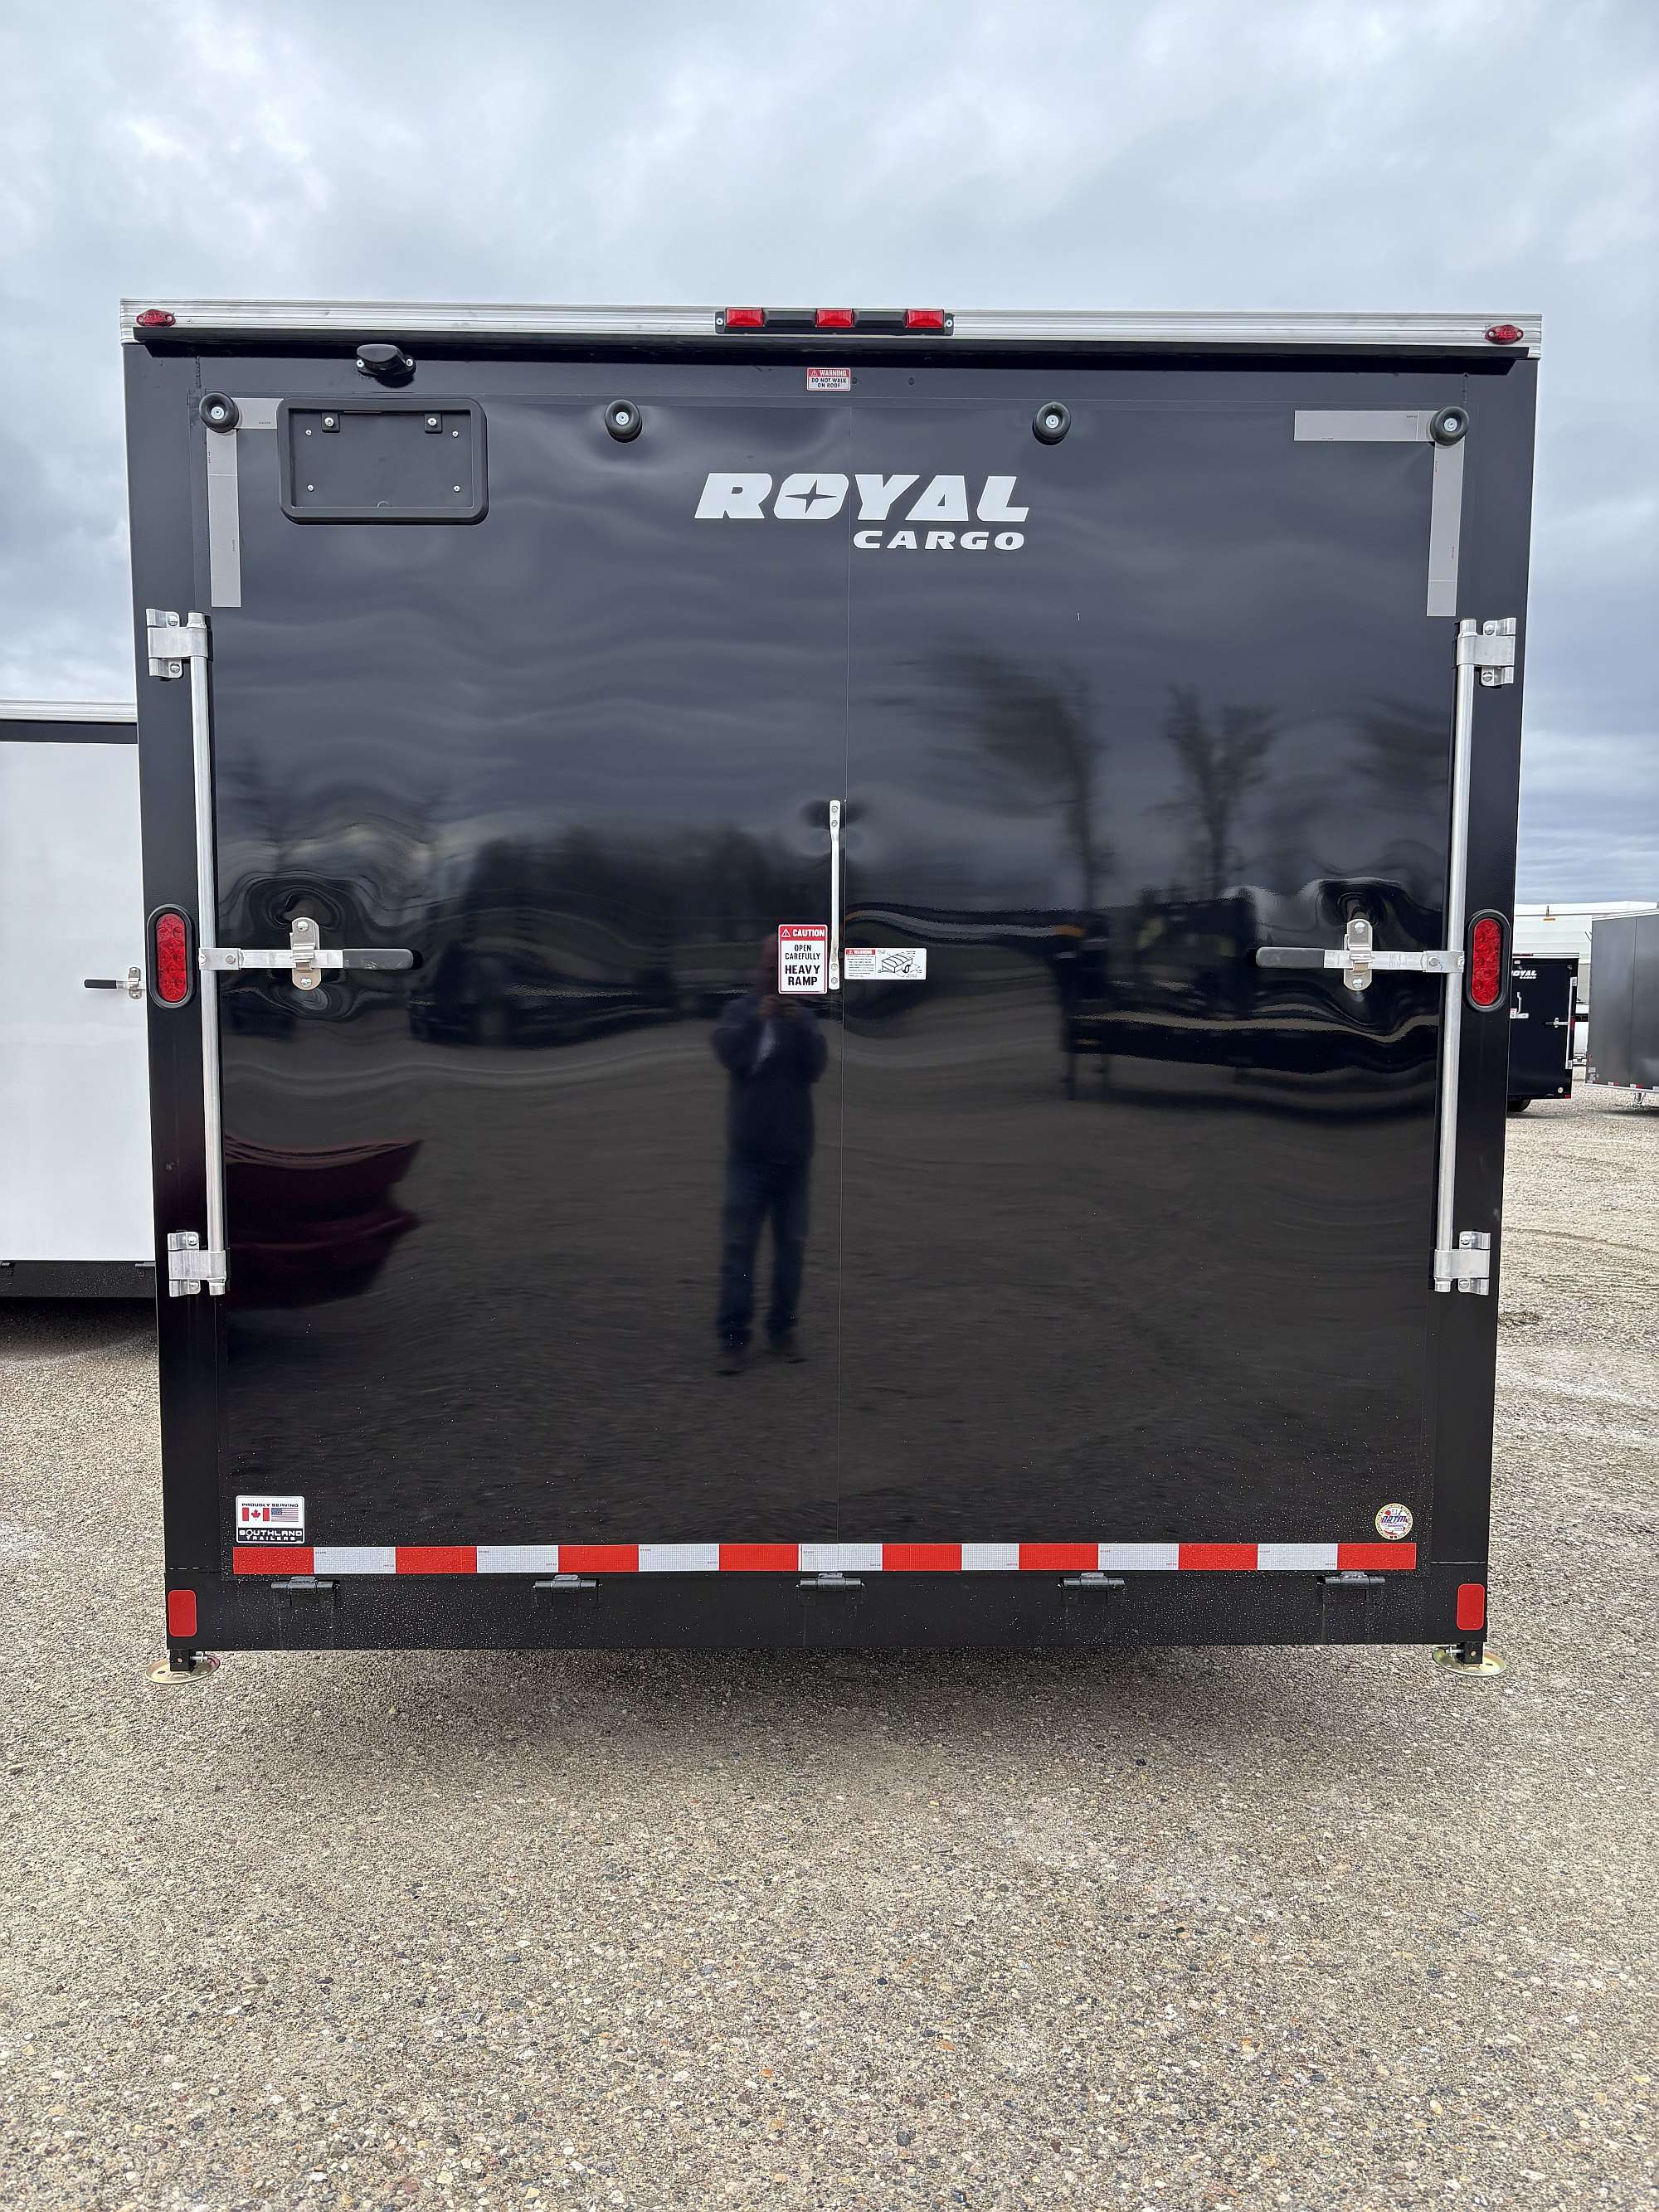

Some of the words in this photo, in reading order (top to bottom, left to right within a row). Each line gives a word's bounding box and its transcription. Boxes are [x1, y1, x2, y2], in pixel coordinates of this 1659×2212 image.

[693, 472, 1029, 523] ROYAL
[853, 530, 1025, 551] CARGO
[792, 928, 825, 937] CAUTION
[794, 944, 812, 952] OPEN
[785, 952, 820, 960] CAREFULLY
[785, 965, 820, 975] HEAVY
[787, 976, 818, 986] RAMP
[239, 1529, 303, 1537] SOUTHLAND
